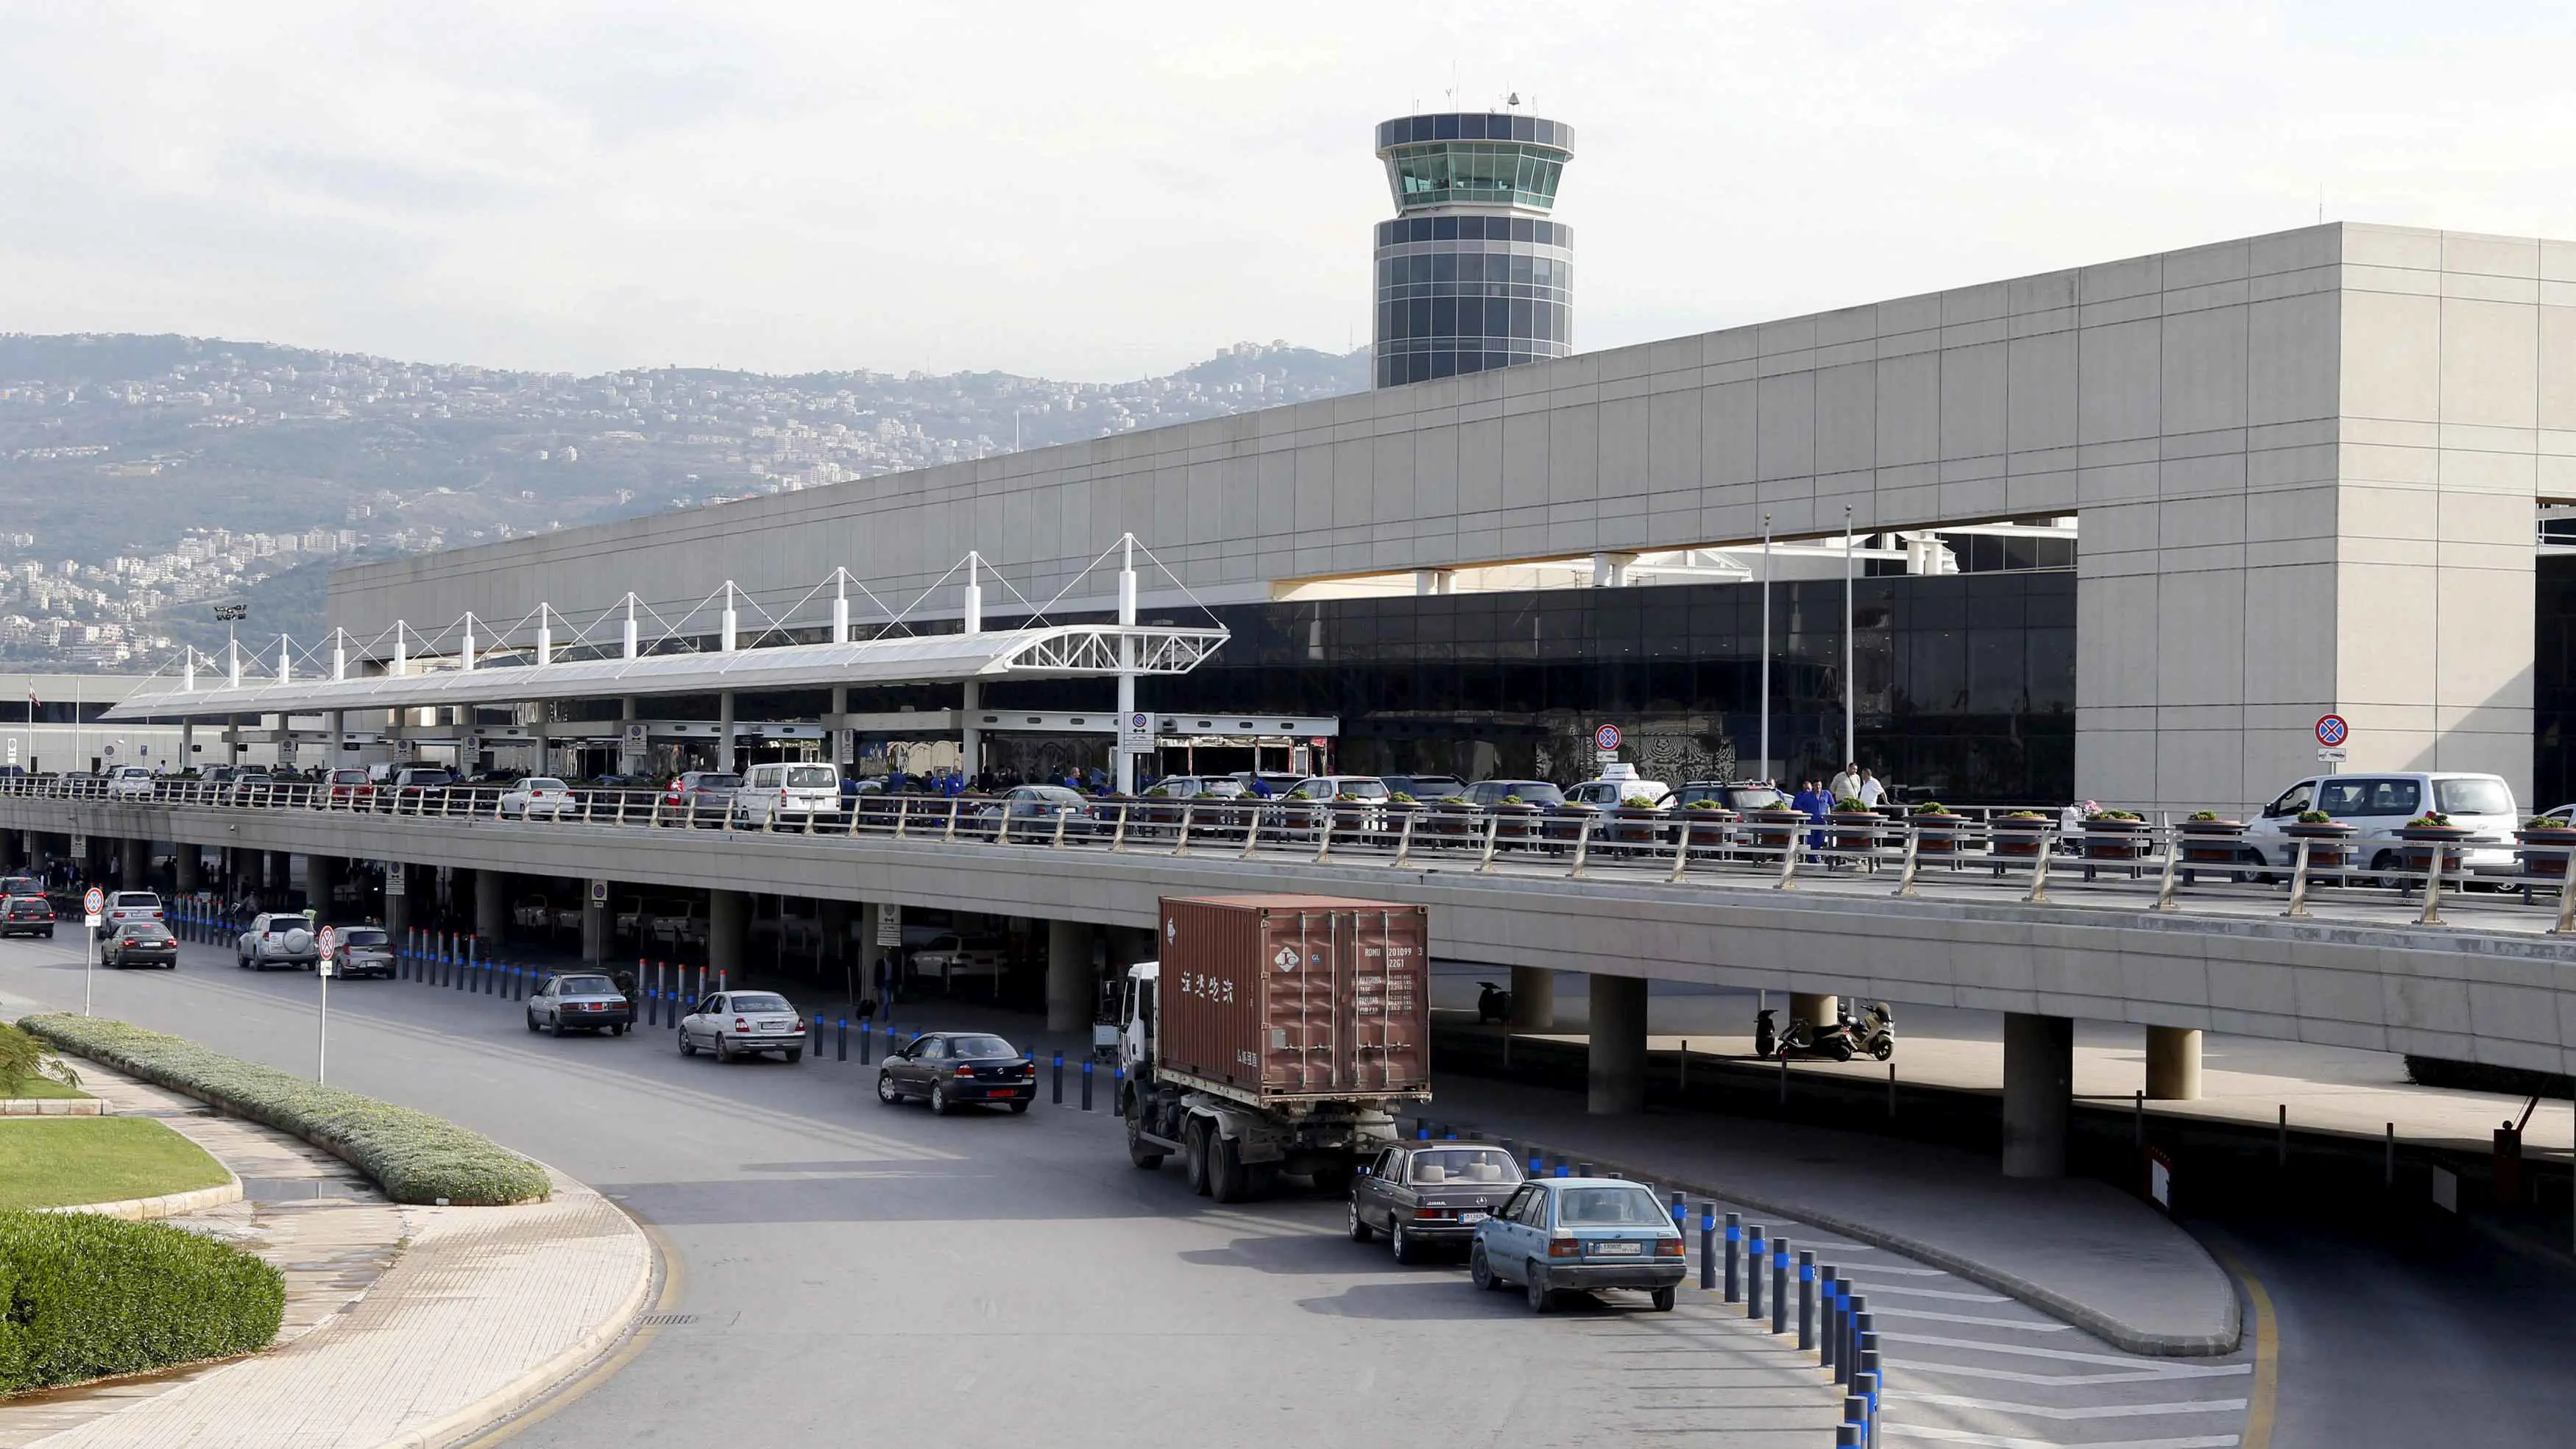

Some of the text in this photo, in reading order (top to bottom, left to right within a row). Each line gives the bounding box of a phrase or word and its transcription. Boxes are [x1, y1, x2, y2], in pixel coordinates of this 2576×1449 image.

[1389, 948, 1412, 956] 201099
[1418, 946, 1423, 956] 3
[1389, 959, 1404, 968] 22G1
